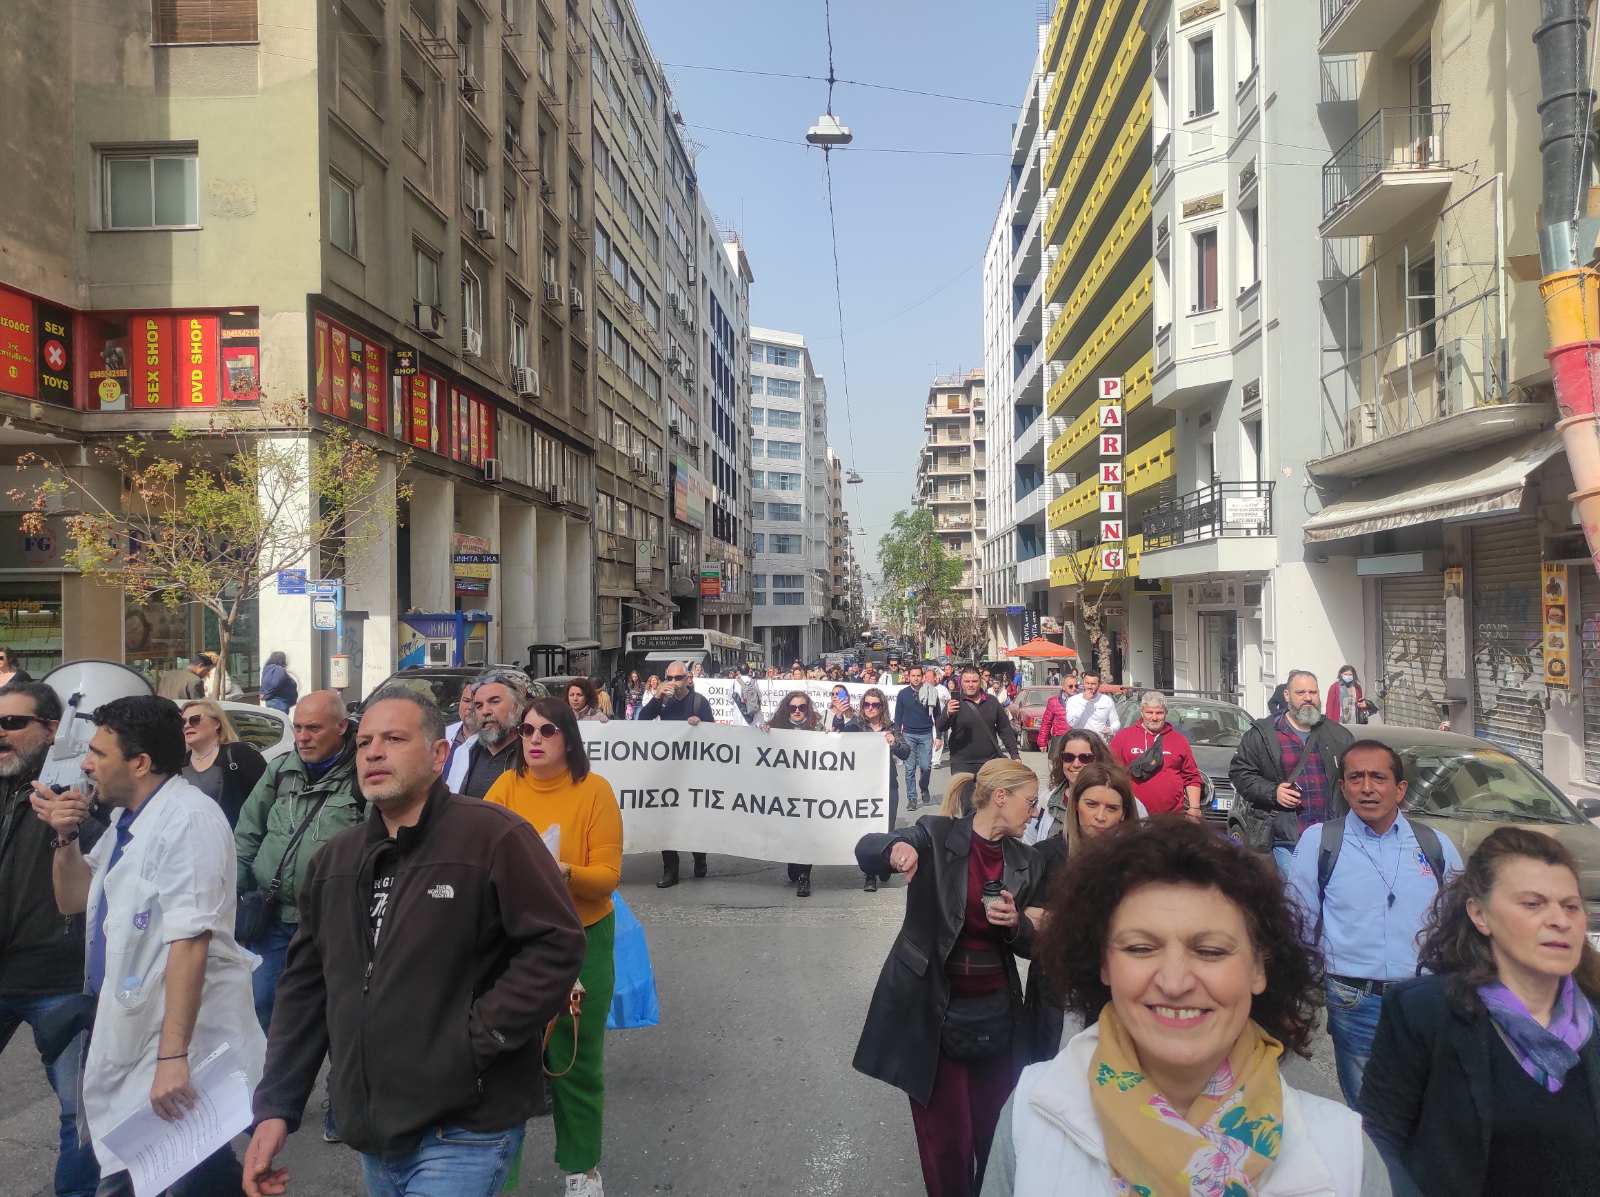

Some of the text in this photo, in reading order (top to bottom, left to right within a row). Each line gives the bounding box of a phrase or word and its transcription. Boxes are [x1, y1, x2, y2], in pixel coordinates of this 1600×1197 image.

[44, 321, 65, 336] SEX
[146, 319, 160, 404] SEX SHOP
[190, 319, 204, 403] DVD SHOP
[394, 367, 417, 375] SHOP
[42, 374, 70, 391] TOYS
[1103, 380, 1121, 568] PARKING
[708, 686, 724, 695] ΟΧΙ
[708, 698, 724, 706] ΟΧΙ
[582, 740, 855, 771] ΕΙΟΝΟΜΙΚΟΙ ΧΑΝΙΩΝ
[619, 787, 884, 819] ΠΙΣΩ ΤΙΣ ΑΝΑΣΤΟΛΕΣ
